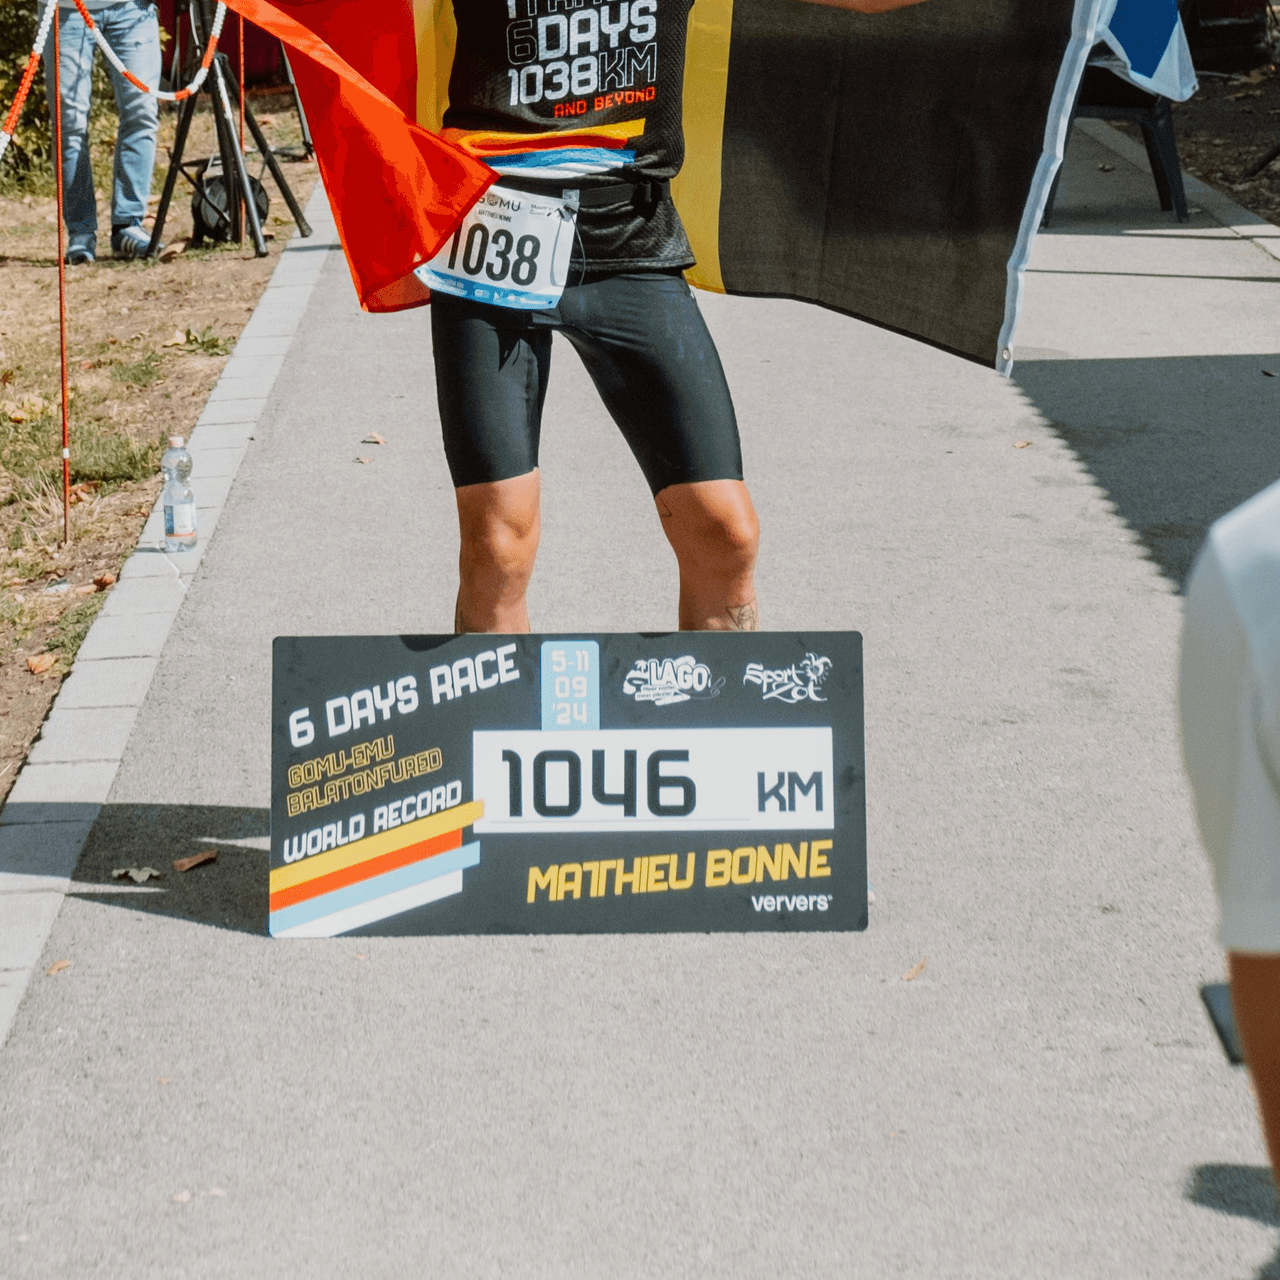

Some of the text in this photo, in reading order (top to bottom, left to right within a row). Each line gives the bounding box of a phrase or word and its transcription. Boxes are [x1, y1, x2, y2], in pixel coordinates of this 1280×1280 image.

[553, 86, 656, 118] AND BEYOND
[447, 220, 541, 286] 1038
[550, 649, 589, 672] 5-11
[554, 675, 588, 699] 09
[648, 658, 712, 692] LAGO
[289, 643, 520, 748] 6 DAYS RACE
[286, 747, 443, 817] BALATONFURED
[288, 734, 395, 789] GOMU-EMU
[502, 749, 823, 817] 1046 KM
[283, 779, 462, 863] WORLD RECORD
[527, 839, 833, 903] MATTHIEU BONNE
[752, 894, 830, 911] ververs
